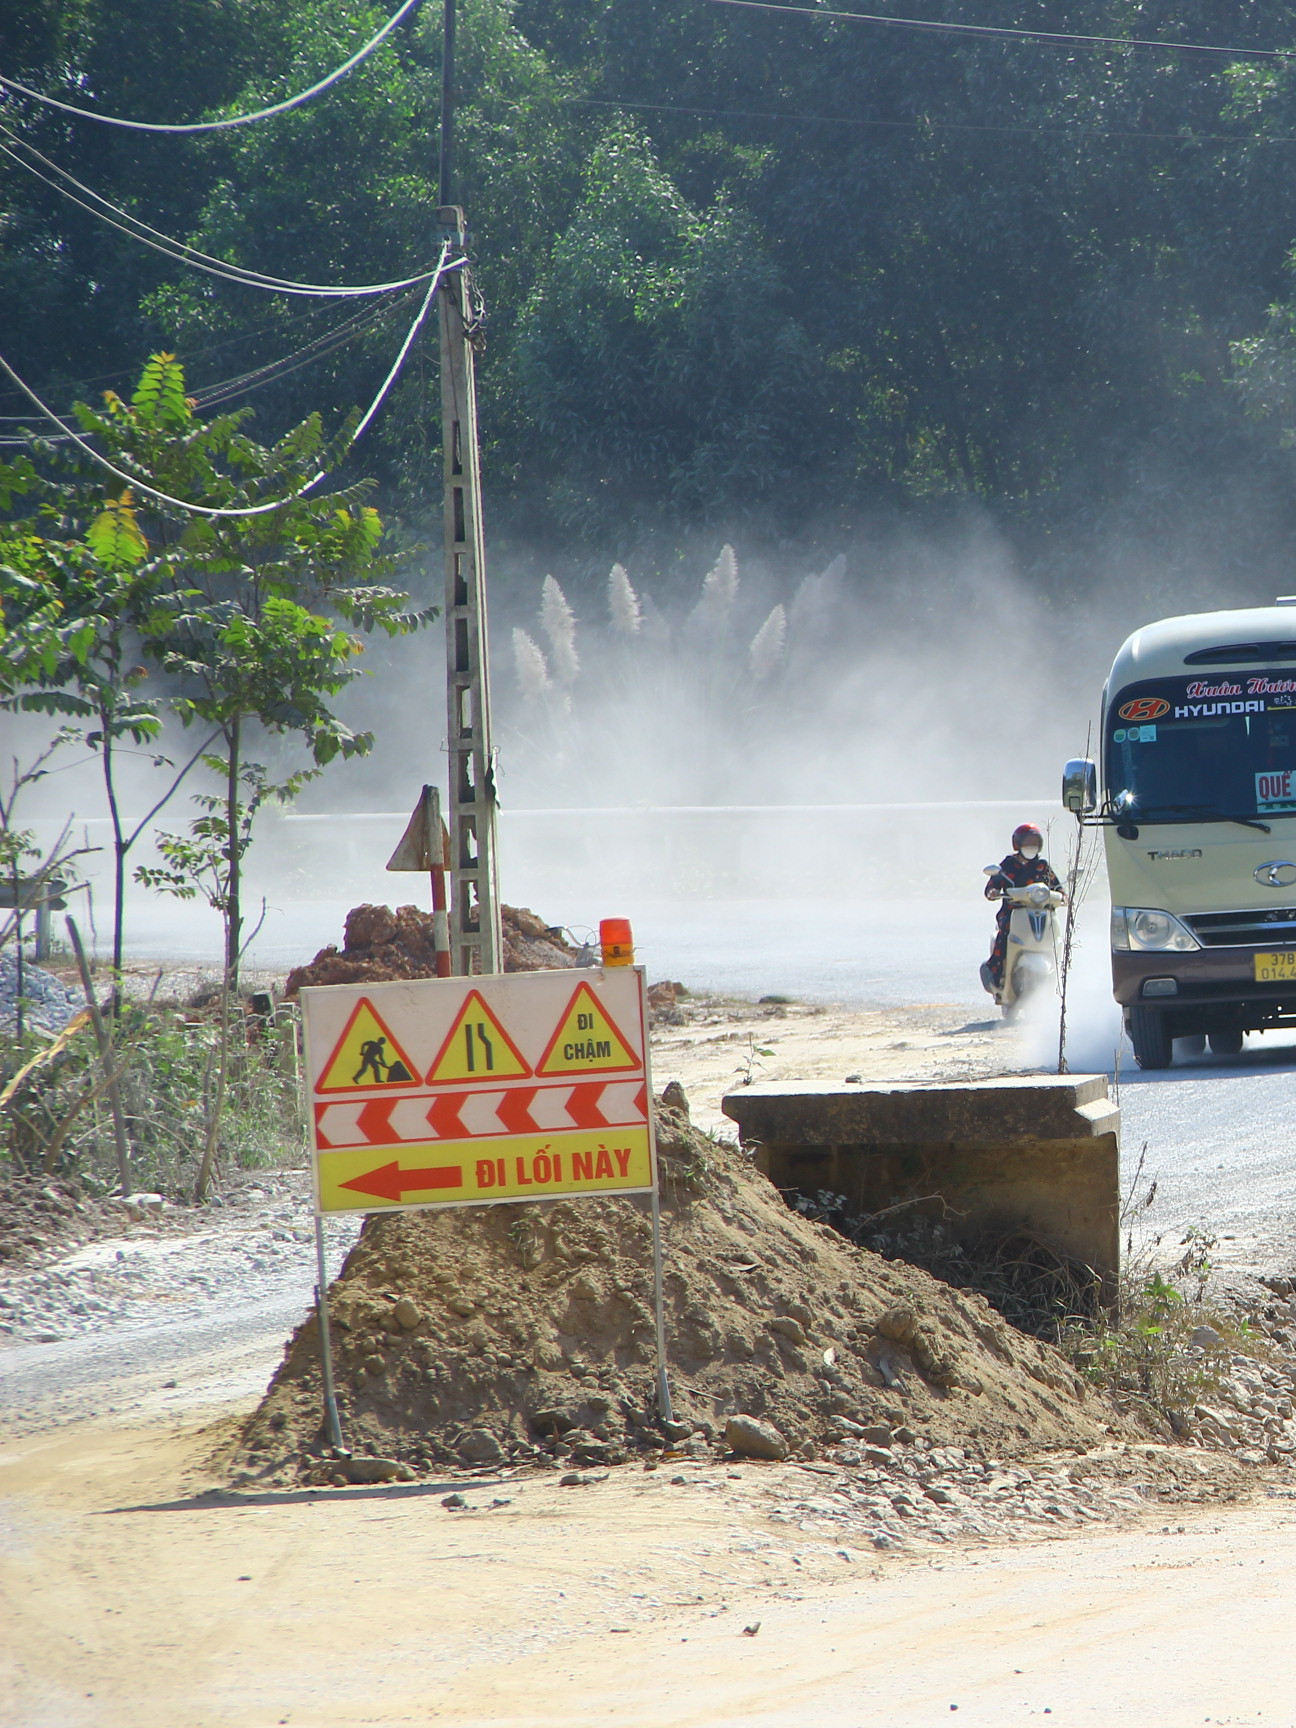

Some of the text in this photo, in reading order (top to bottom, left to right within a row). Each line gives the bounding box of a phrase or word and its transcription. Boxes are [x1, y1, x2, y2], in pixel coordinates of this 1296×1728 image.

[1186, 681, 1242, 699] Xuân
[1174, 700, 1265, 718] HYUNDAI
[1258, 770, 1293, 800] QUẾ
[1147, 849, 1203, 861] THACO
[1271, 953, 1295, 966] 37B
[577, 1013, 594, 1030] ĐI
[564, 1039, 611, 1062] CHẬM
[475, 1144, 632, 1189] ĐI LỐI NÀY
